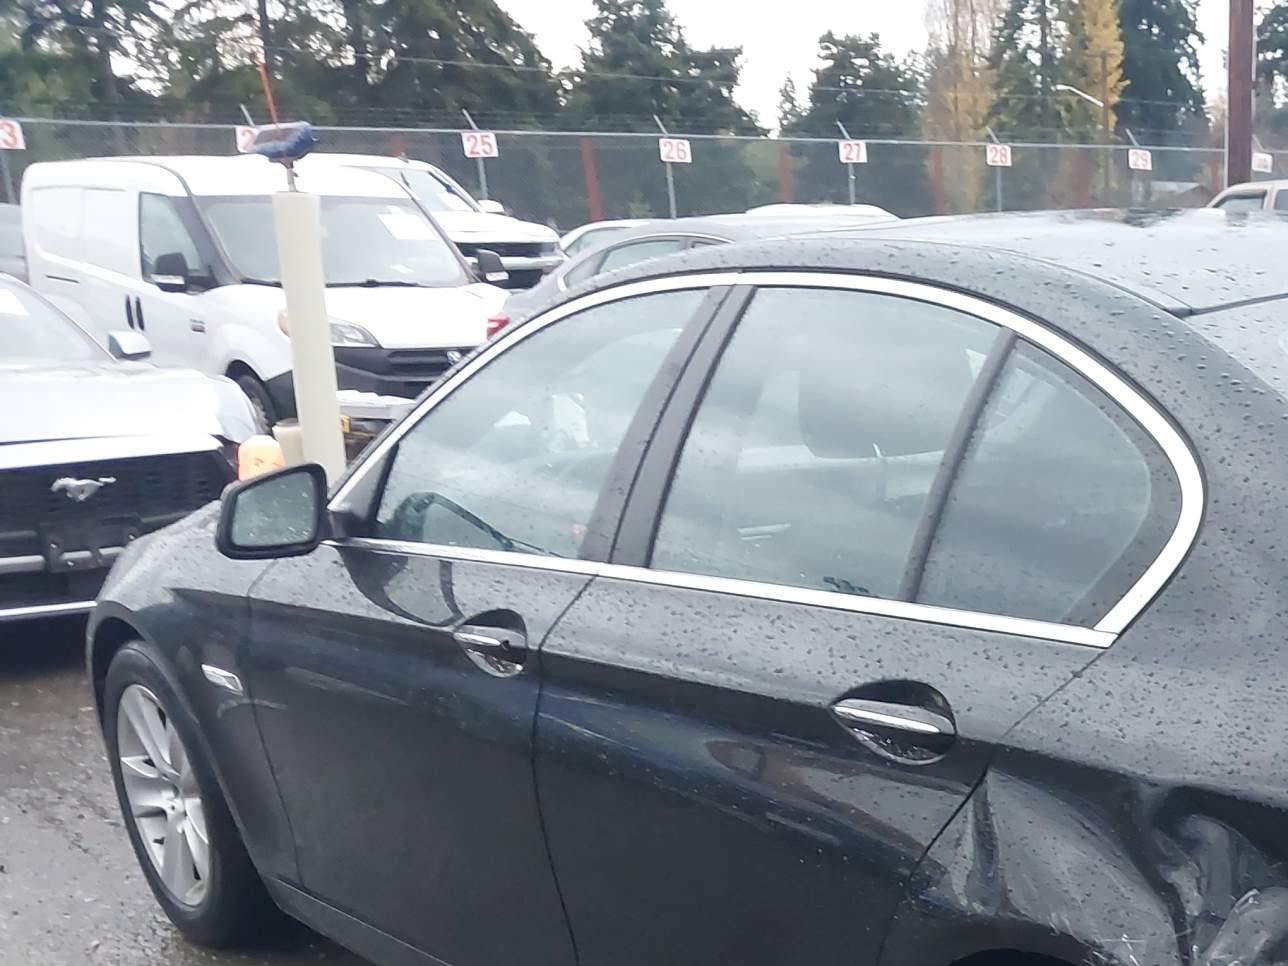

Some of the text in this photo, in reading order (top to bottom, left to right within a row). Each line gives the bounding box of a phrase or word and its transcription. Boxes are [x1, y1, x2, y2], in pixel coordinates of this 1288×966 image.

[0, 124, 17, 148] 3
[467, 135, 494, 156] 25
[663, 142, 687, 160] 26
[843, 143, 861, 161] 27
[989, 147, 1009, 164] 28
[1132, 153, 1148, 168] 29
